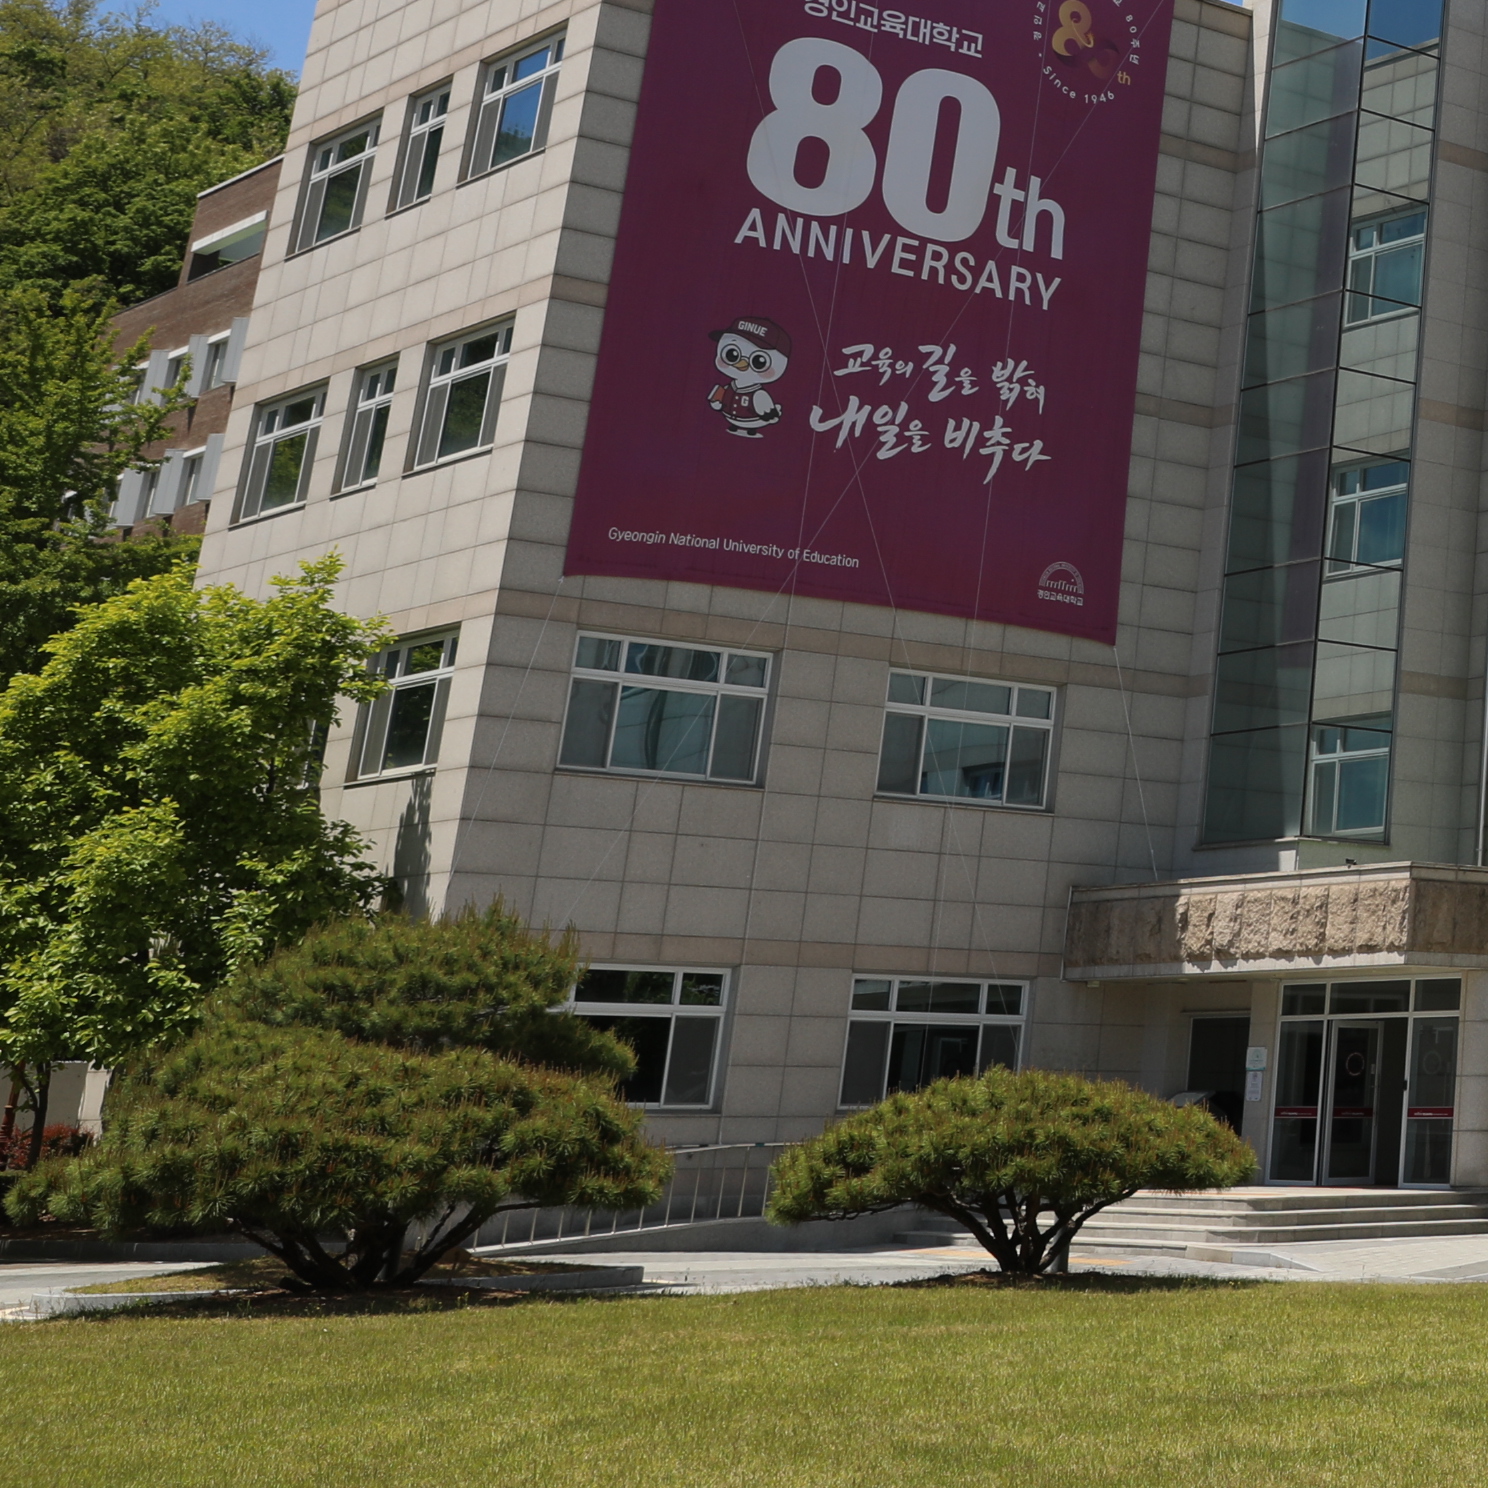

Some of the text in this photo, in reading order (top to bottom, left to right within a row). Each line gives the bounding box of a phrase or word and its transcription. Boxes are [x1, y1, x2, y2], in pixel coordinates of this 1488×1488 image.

[1042, 66, 1115, 104] Since 1946
[734, 208, 1062, 311] ANNIVERSARY
[737, 320, 768, 337] GINUE
[833, 343, 1045, 414] 교육의 길을 밝혀
[740, 395, 749, 407] G
[809, 395, 1052, 485] 내일을 비추다
[608, 527, 860, 568] Gyeongin National University of Education
